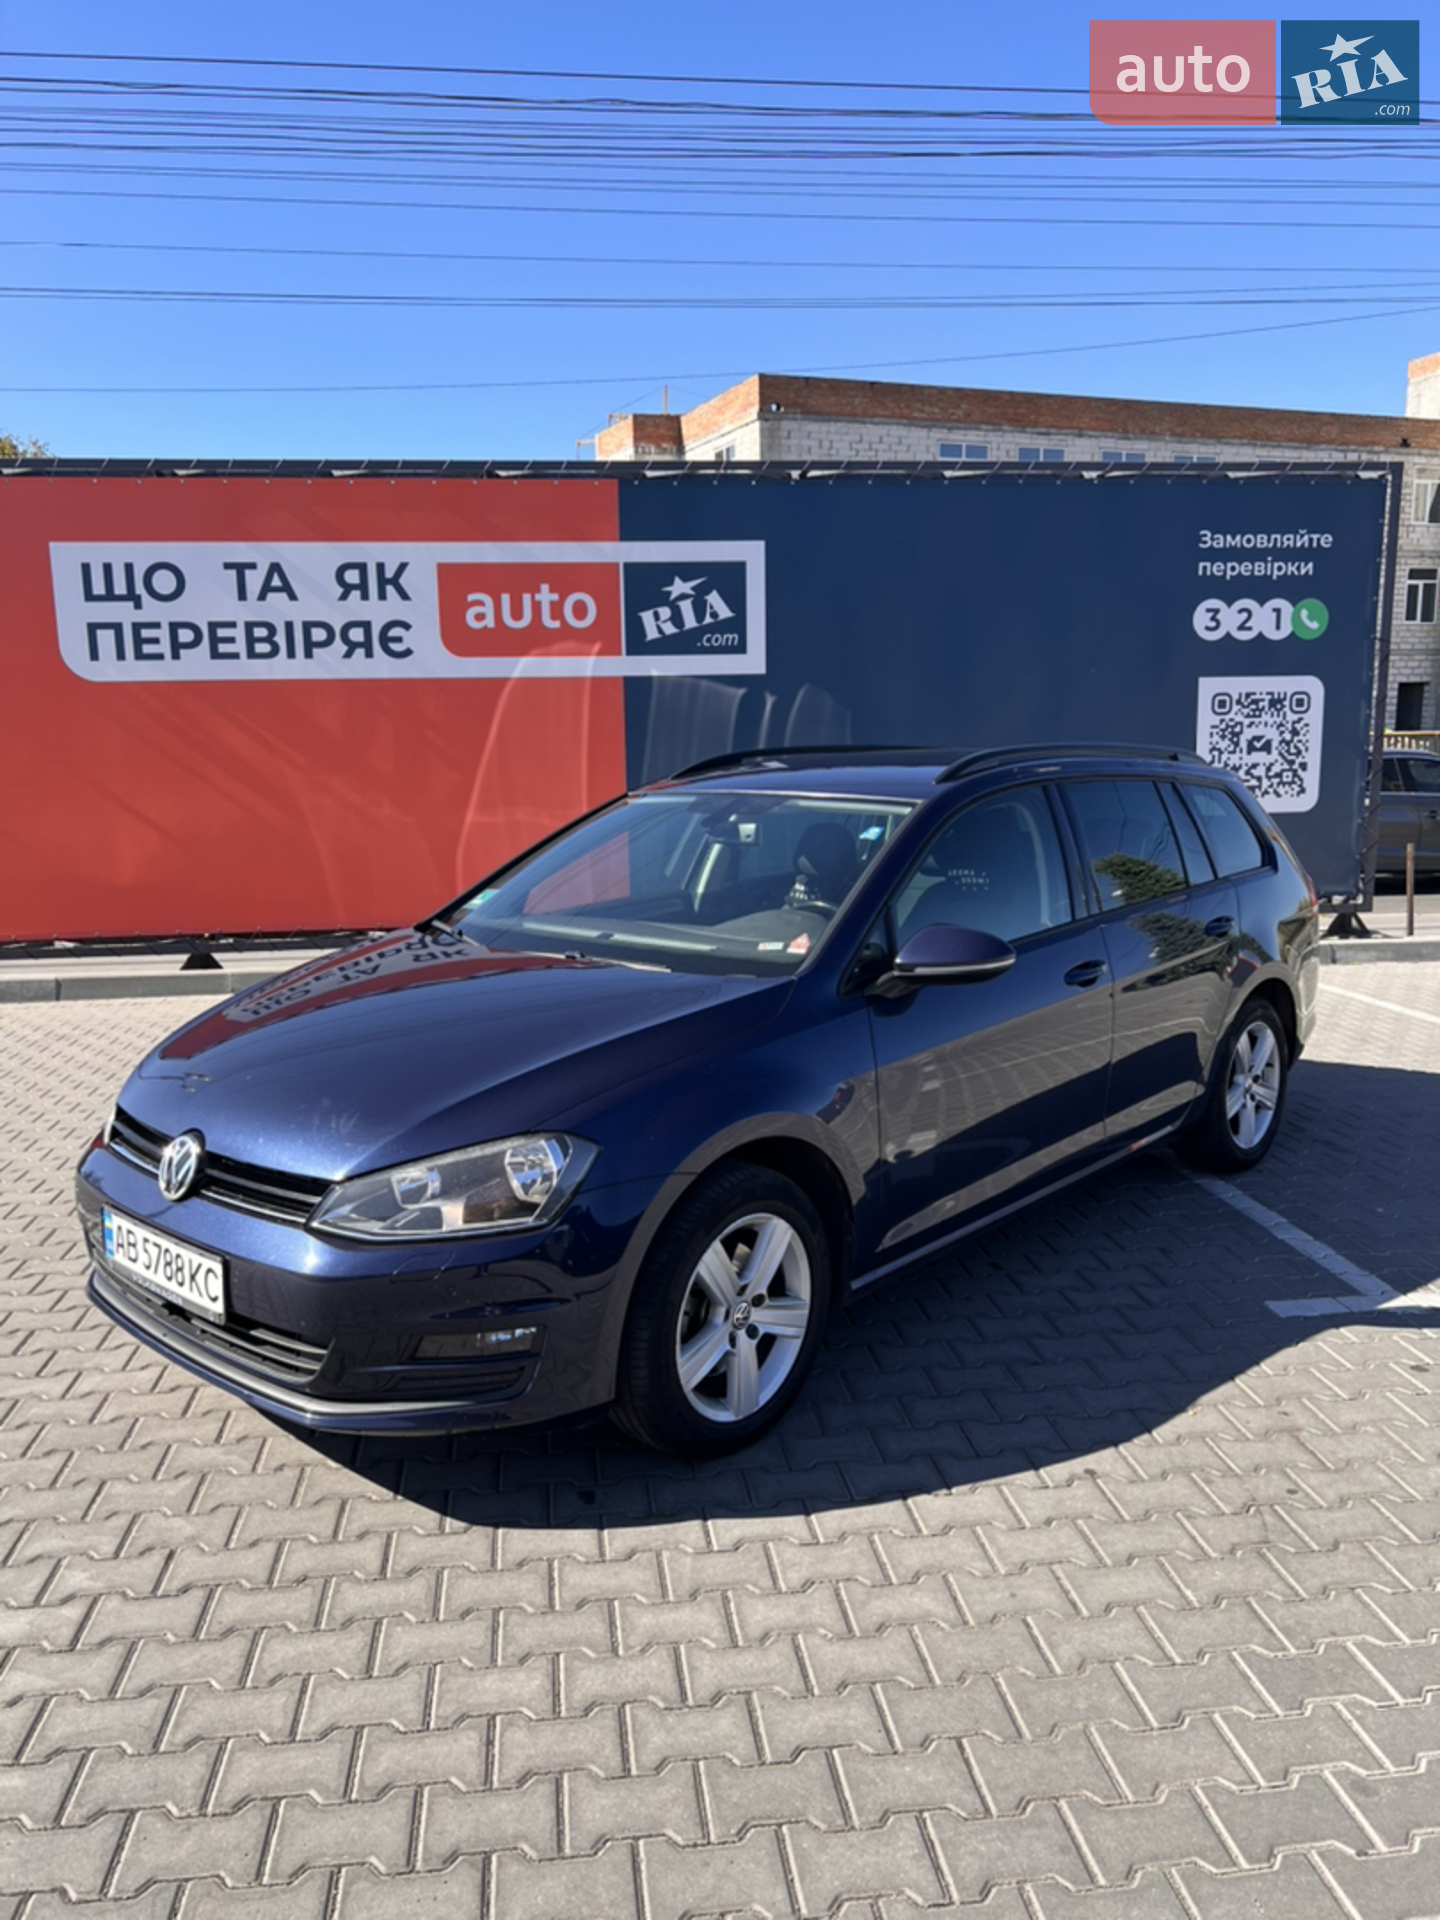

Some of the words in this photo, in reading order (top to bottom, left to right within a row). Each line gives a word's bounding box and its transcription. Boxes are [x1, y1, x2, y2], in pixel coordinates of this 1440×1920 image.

[1198, 529, 1334, 549] Замовляйте
[1198, 556, 1314, 580] перевірки
[80, 561, 187, 610] ЩО
[223, 561, 300, 601] ТА
[334, 561, 413, 601] ЯК
[465, 583, 598, 630] auto
[637, 589, 736, 642] RIA
[86, 619, 415, 661] ПЕРЕВІРЯЄ
[696, 633, 739, 646] .com
